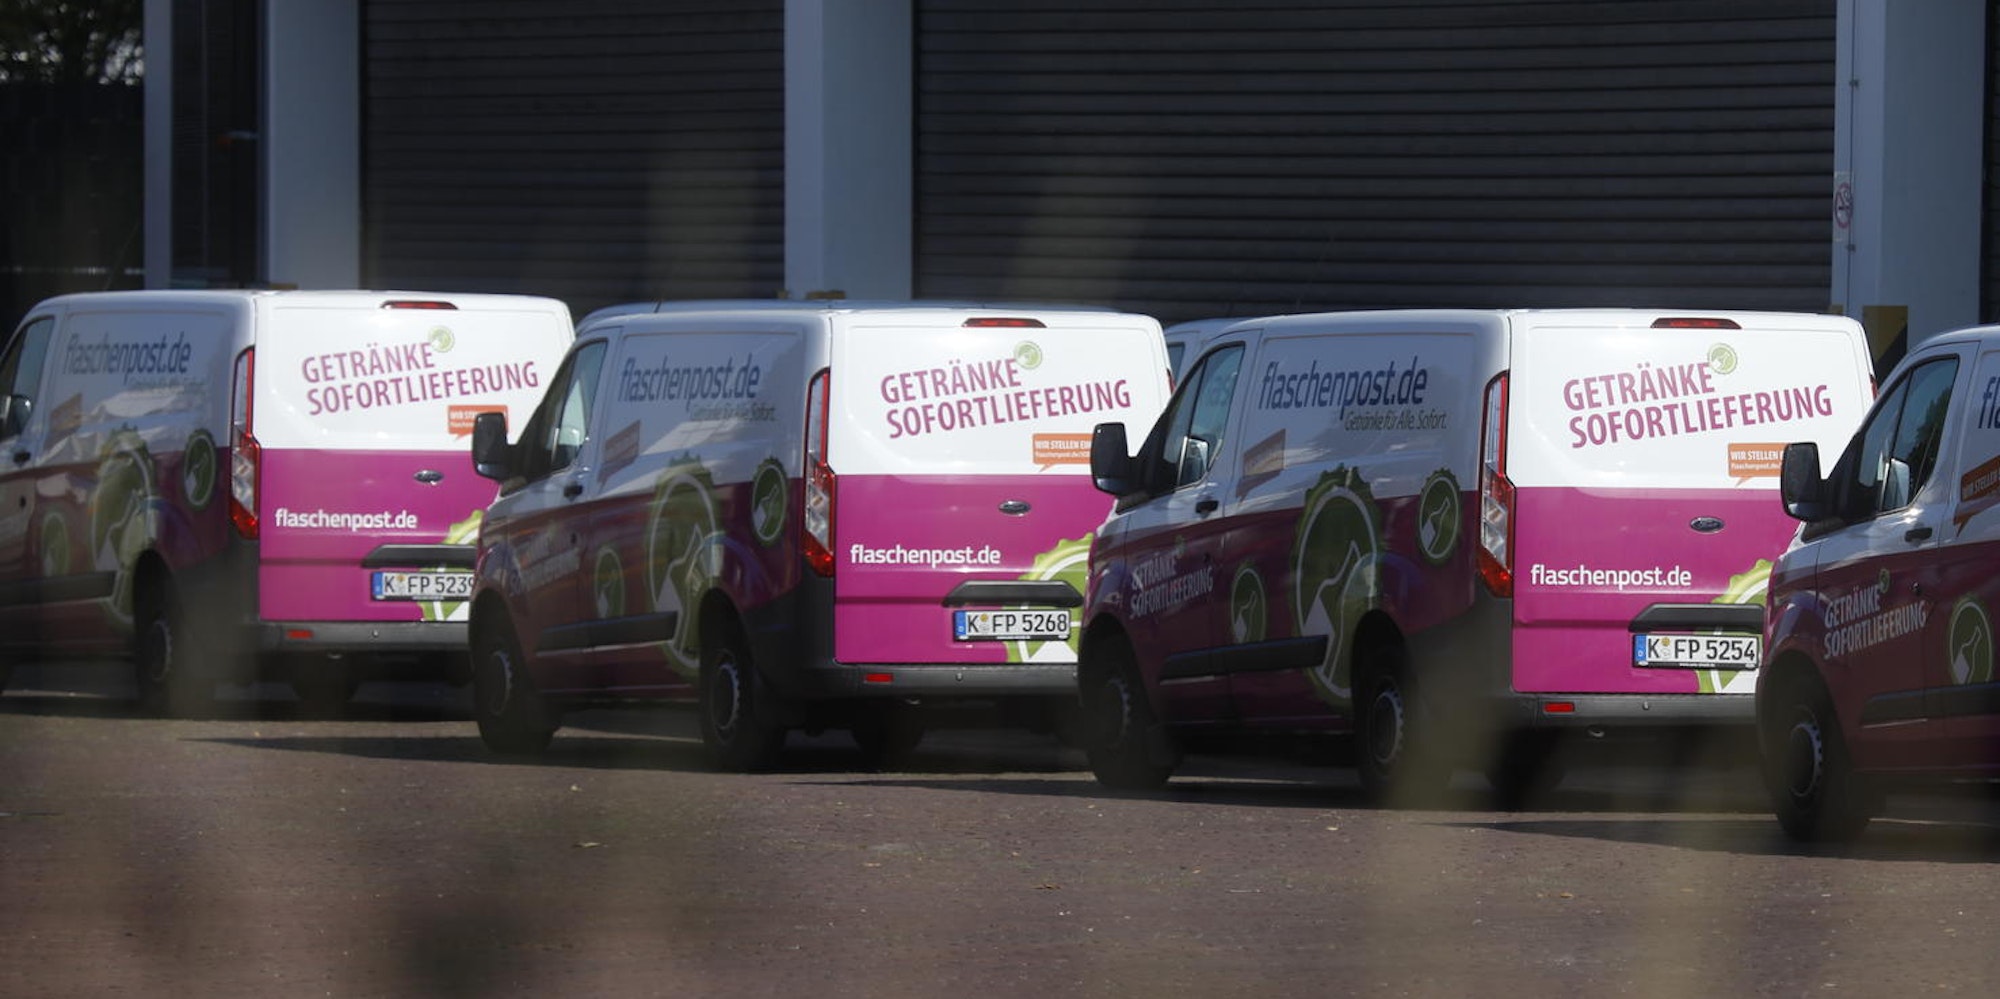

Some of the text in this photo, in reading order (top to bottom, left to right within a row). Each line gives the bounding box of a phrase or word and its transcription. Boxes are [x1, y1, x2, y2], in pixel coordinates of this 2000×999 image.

[302, 342, 435, 383] GETRÄNKE
[618, 353, 760, 413] flaschenpost.de
[881, 359, 1021, 403] GETRÄNKE
[307, 361, 539, 415] SOFORTLIEFERUNG
[1258, 355, 1428, 421] flaschenpost.de
[1563, 362, 1715, 411] GETRÄNKE
[886, 380, 1131, 438] SOFORTLIEFERUNG
[1569, 385, 1832, 448] SOFORTLIEFERUNG
[1050, 440, 1078, 449] STELLEN
[1731, 450, 1746, 460] WIR
[1747, 450, 1780, 460] STELLEN
[275, 508, 417, 532] flaschenpost.de
[850, 544, 1001, 568] flaschenpost.de
[384, 575, 395, 593] K
[407, 575, 430, 593] FP
[1531, 564, 1692, 591] flaschenpost.de
[967, 613, 1068, 633] K FP 5268
[1824, 584, 1881, 629] GETRÄNKE
[1647, 638, 1755, 660] K FP 5254
[1824, 600, 1927, 660] SOFORTLIEFERUNG
